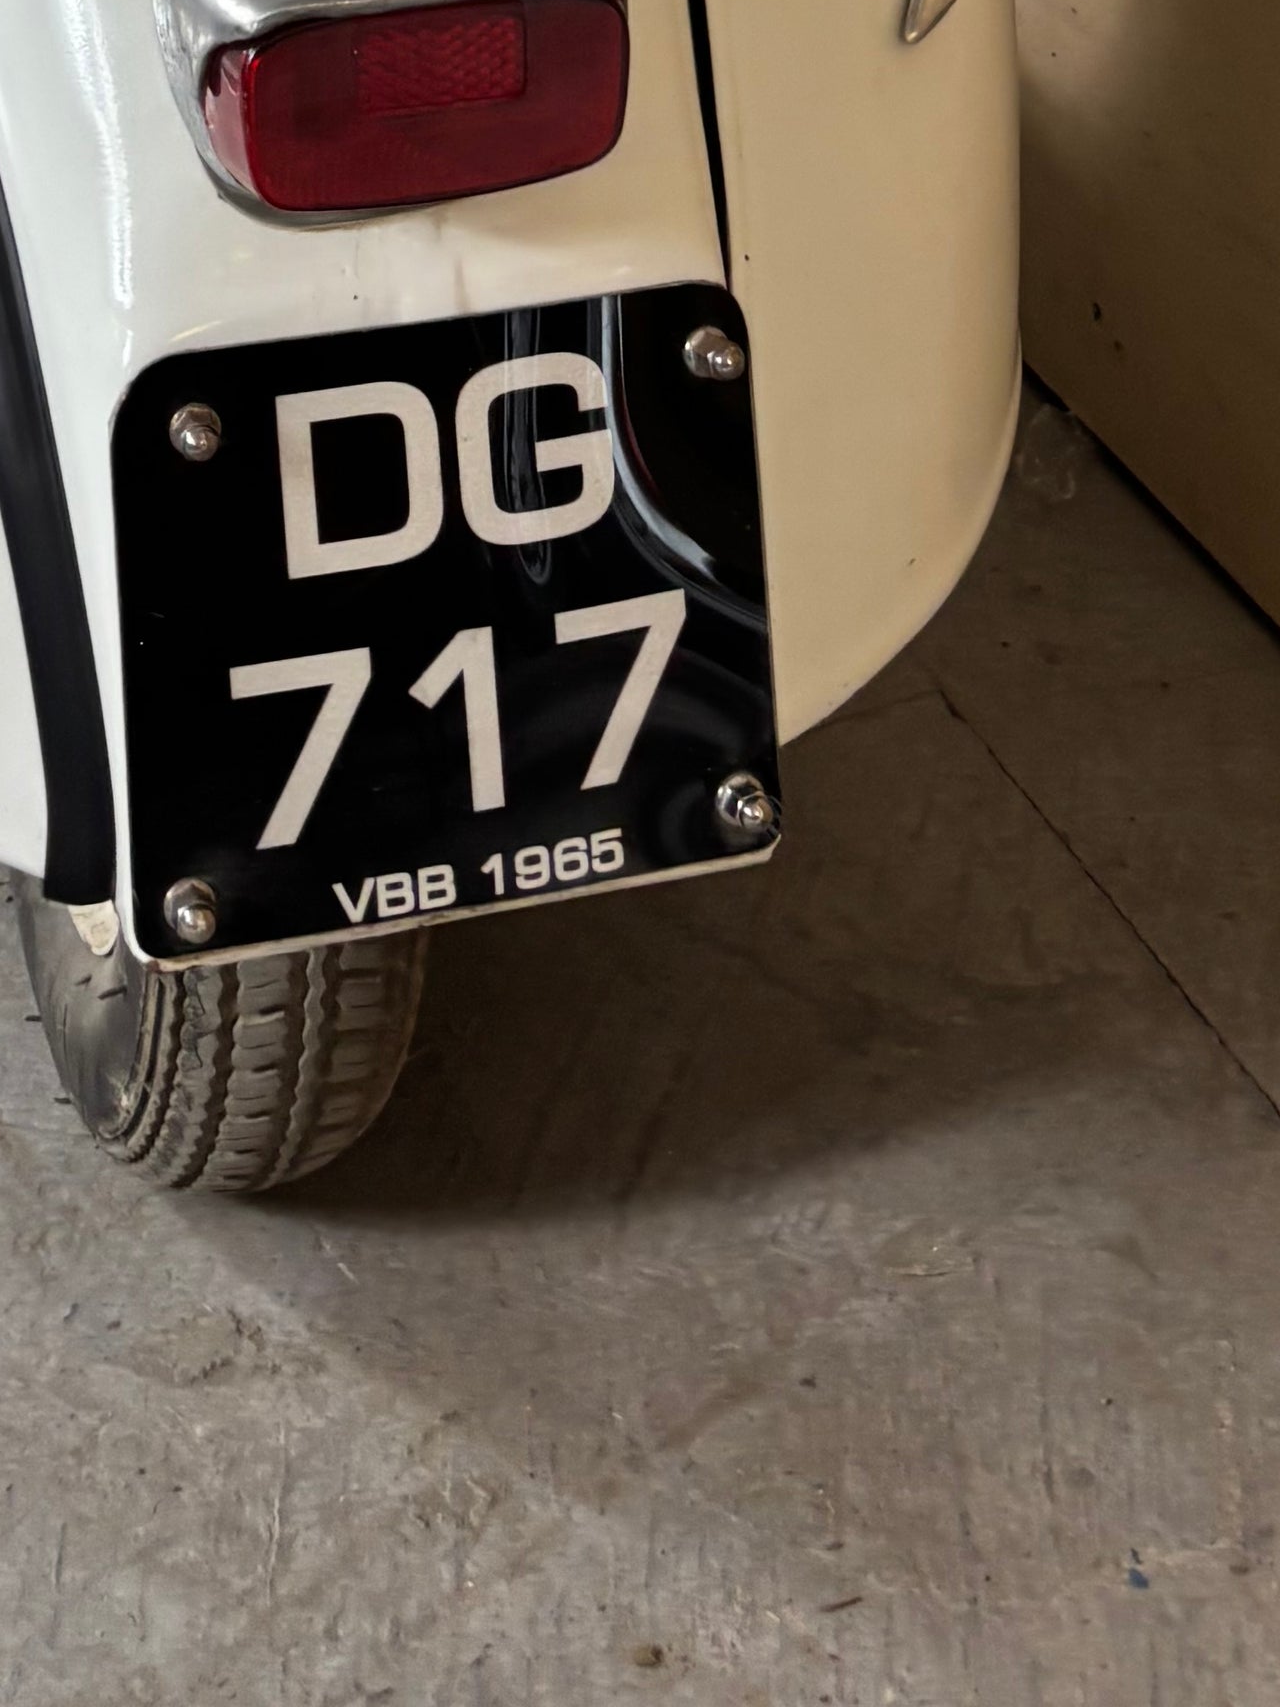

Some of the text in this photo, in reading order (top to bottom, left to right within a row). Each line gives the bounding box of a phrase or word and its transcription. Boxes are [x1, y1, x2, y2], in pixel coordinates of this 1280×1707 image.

[275, 351, 616, 580] DG
[229, 588, 687, 850] 717
[332, 829, 625, 923] VBB 1965
